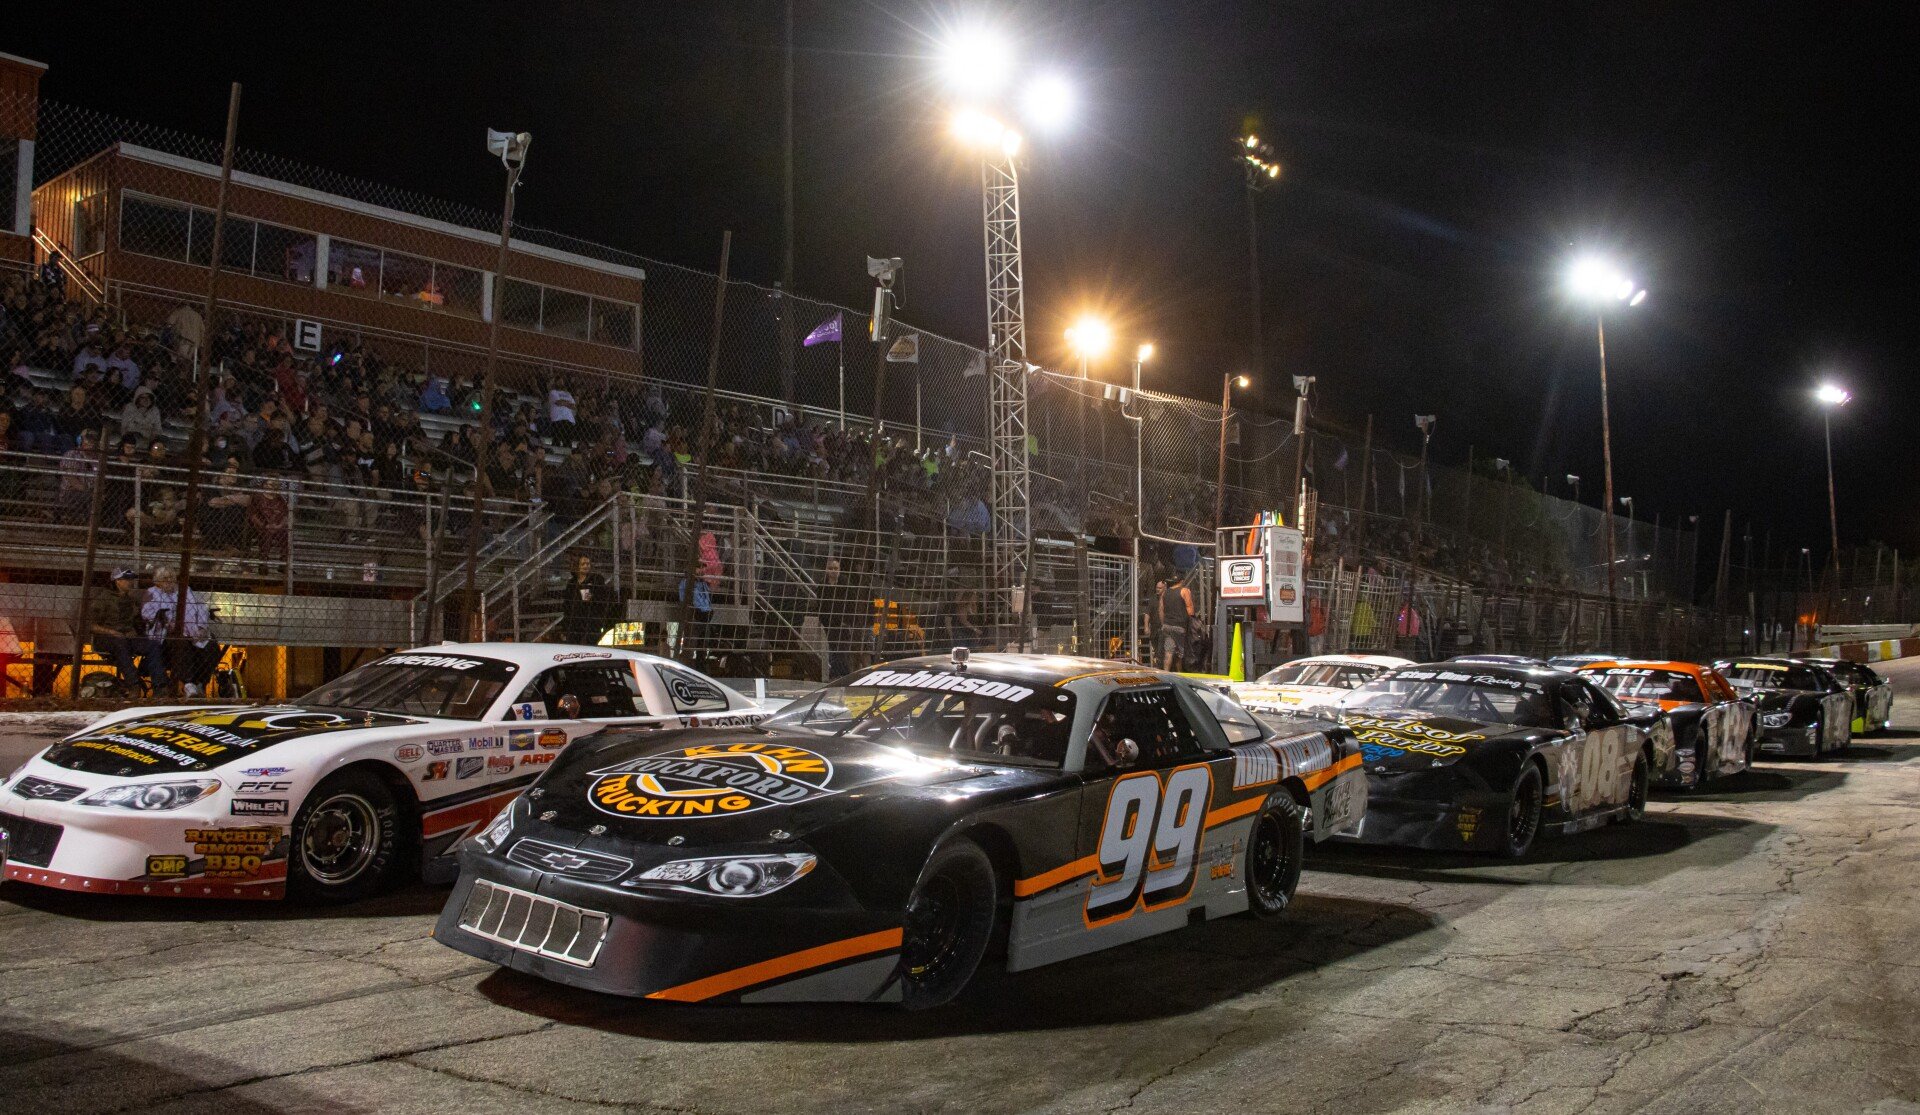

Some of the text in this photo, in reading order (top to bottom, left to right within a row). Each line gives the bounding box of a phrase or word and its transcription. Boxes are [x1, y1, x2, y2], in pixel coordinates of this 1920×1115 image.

[300, 321, 318, 349] E
[1473, 675, 1522, 688] Racing
[1606, 668, 1654, 676] GILLE
[850, 671, 1035, 702] Robinson
[522, 704, 533, 720] 8
[469, 737, 493, 748] Mobil
[106, 742, 160, 765] Contractor
[398, 748, 421, 758] BELL
[520, 754, 556, 766] ARP
[683, 743, 827, 774] KUHN
[1581, 729, 1620, 801] 08
[238, 781, 293, 790] PFC
[613, 757, 810, 802] ROCKFORD
[597, 774, 751, 816] TRUCKING
[233, 800, 286, 812] WHELEN
[1084, 763, 1214, 929] 99
[150, 860, 186, 873] OMP
[204, 854, 262, 876] BBQ
